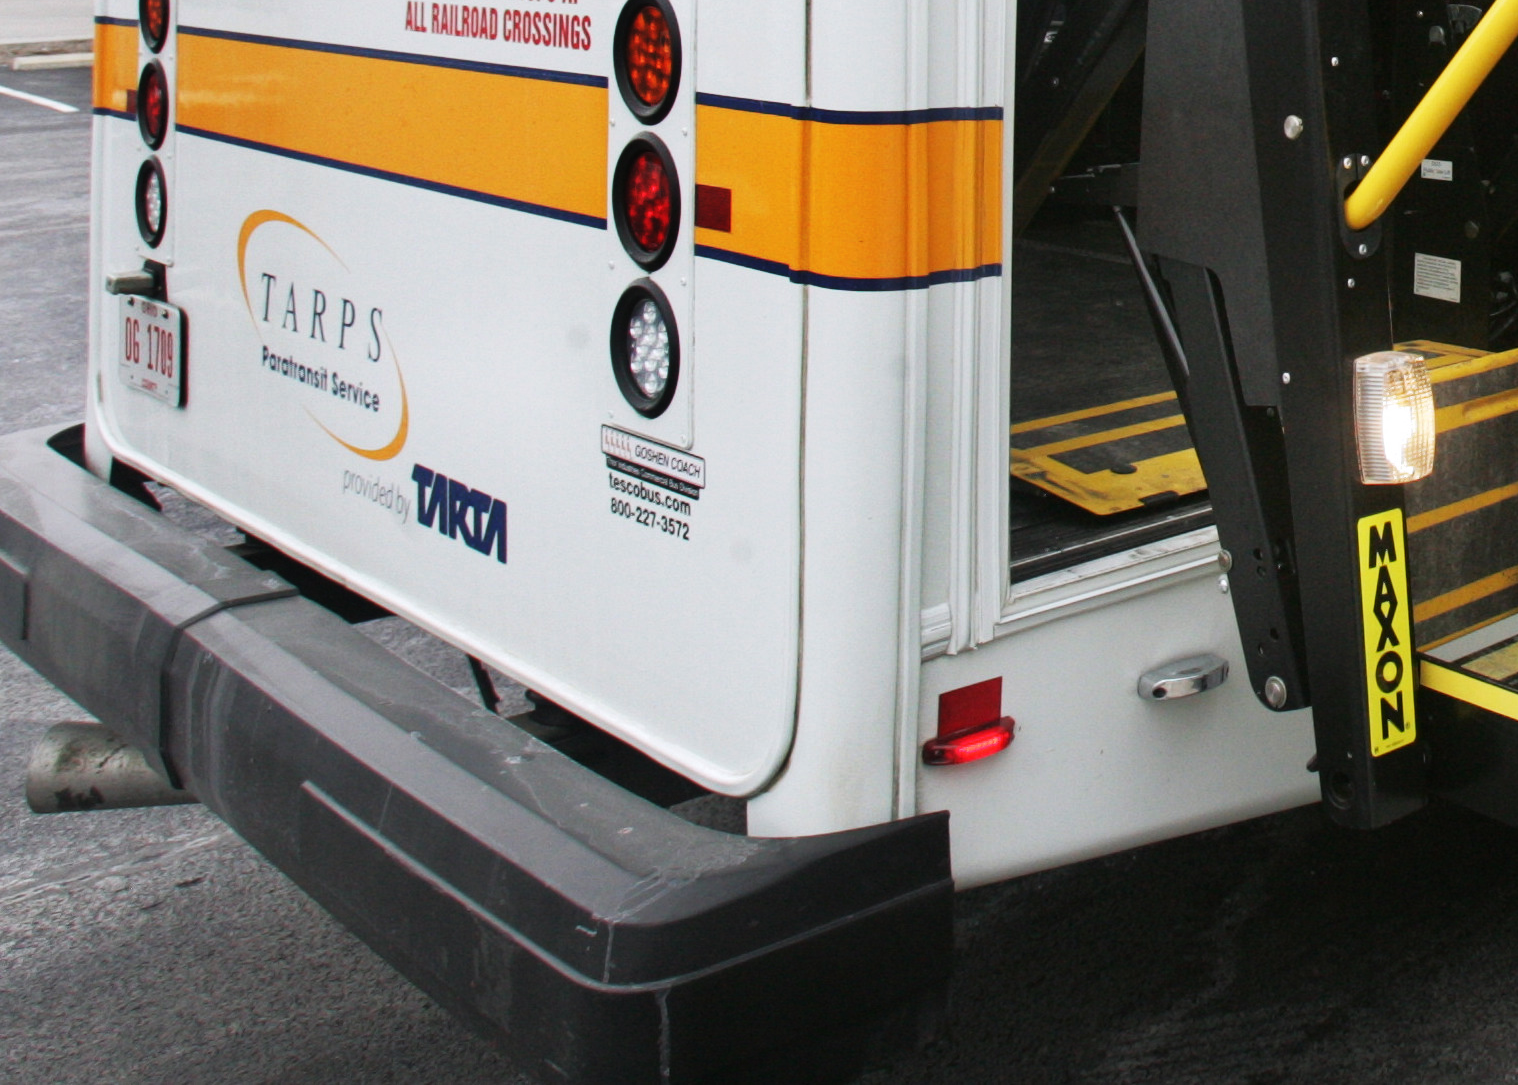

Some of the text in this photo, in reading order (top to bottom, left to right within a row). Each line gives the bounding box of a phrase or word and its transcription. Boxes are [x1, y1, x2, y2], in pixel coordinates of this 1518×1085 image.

[405, 0, 592, 51] ALL RAILROAD CROSSINGS
[261, 272, 383, 363] TARPS
[147, 324, 173, 379] 1709
[262, 345, 380, 412] Paratransit Service
[635, 444, 701, 478] GOSHEN COACH
[343, 469, 412, 524] provided by
[411, 463, 508, 564] TARTA
[609, 472, 691, 516] tescobus.com
[610, 497, 690, 541] 800-227-3572
[1368, 521, 1405, 740] MAXON
